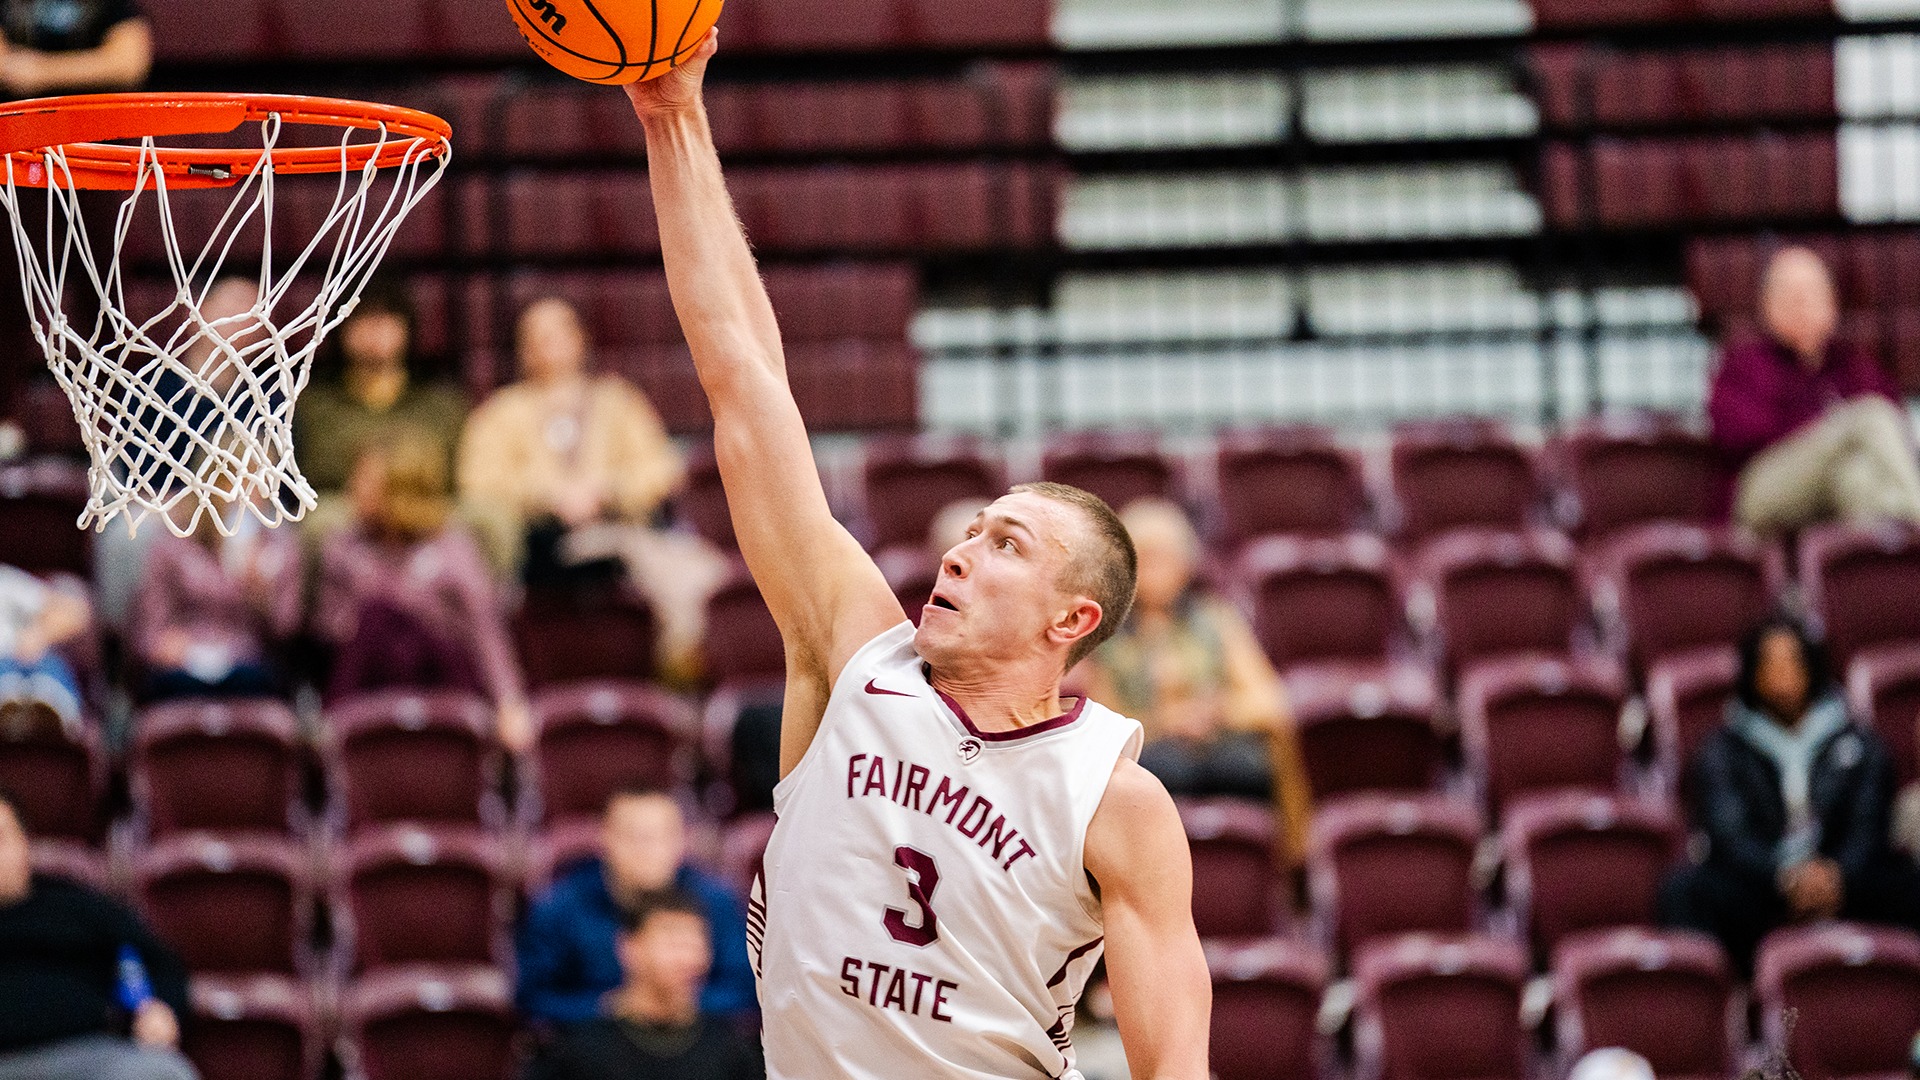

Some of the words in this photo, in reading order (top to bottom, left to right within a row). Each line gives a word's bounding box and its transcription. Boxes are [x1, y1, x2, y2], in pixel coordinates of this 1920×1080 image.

[847, 753, 1037, 872] FAIRMONT
[881, 843, 942, 949] 3
[839, 956, 960, 1023] STATE
